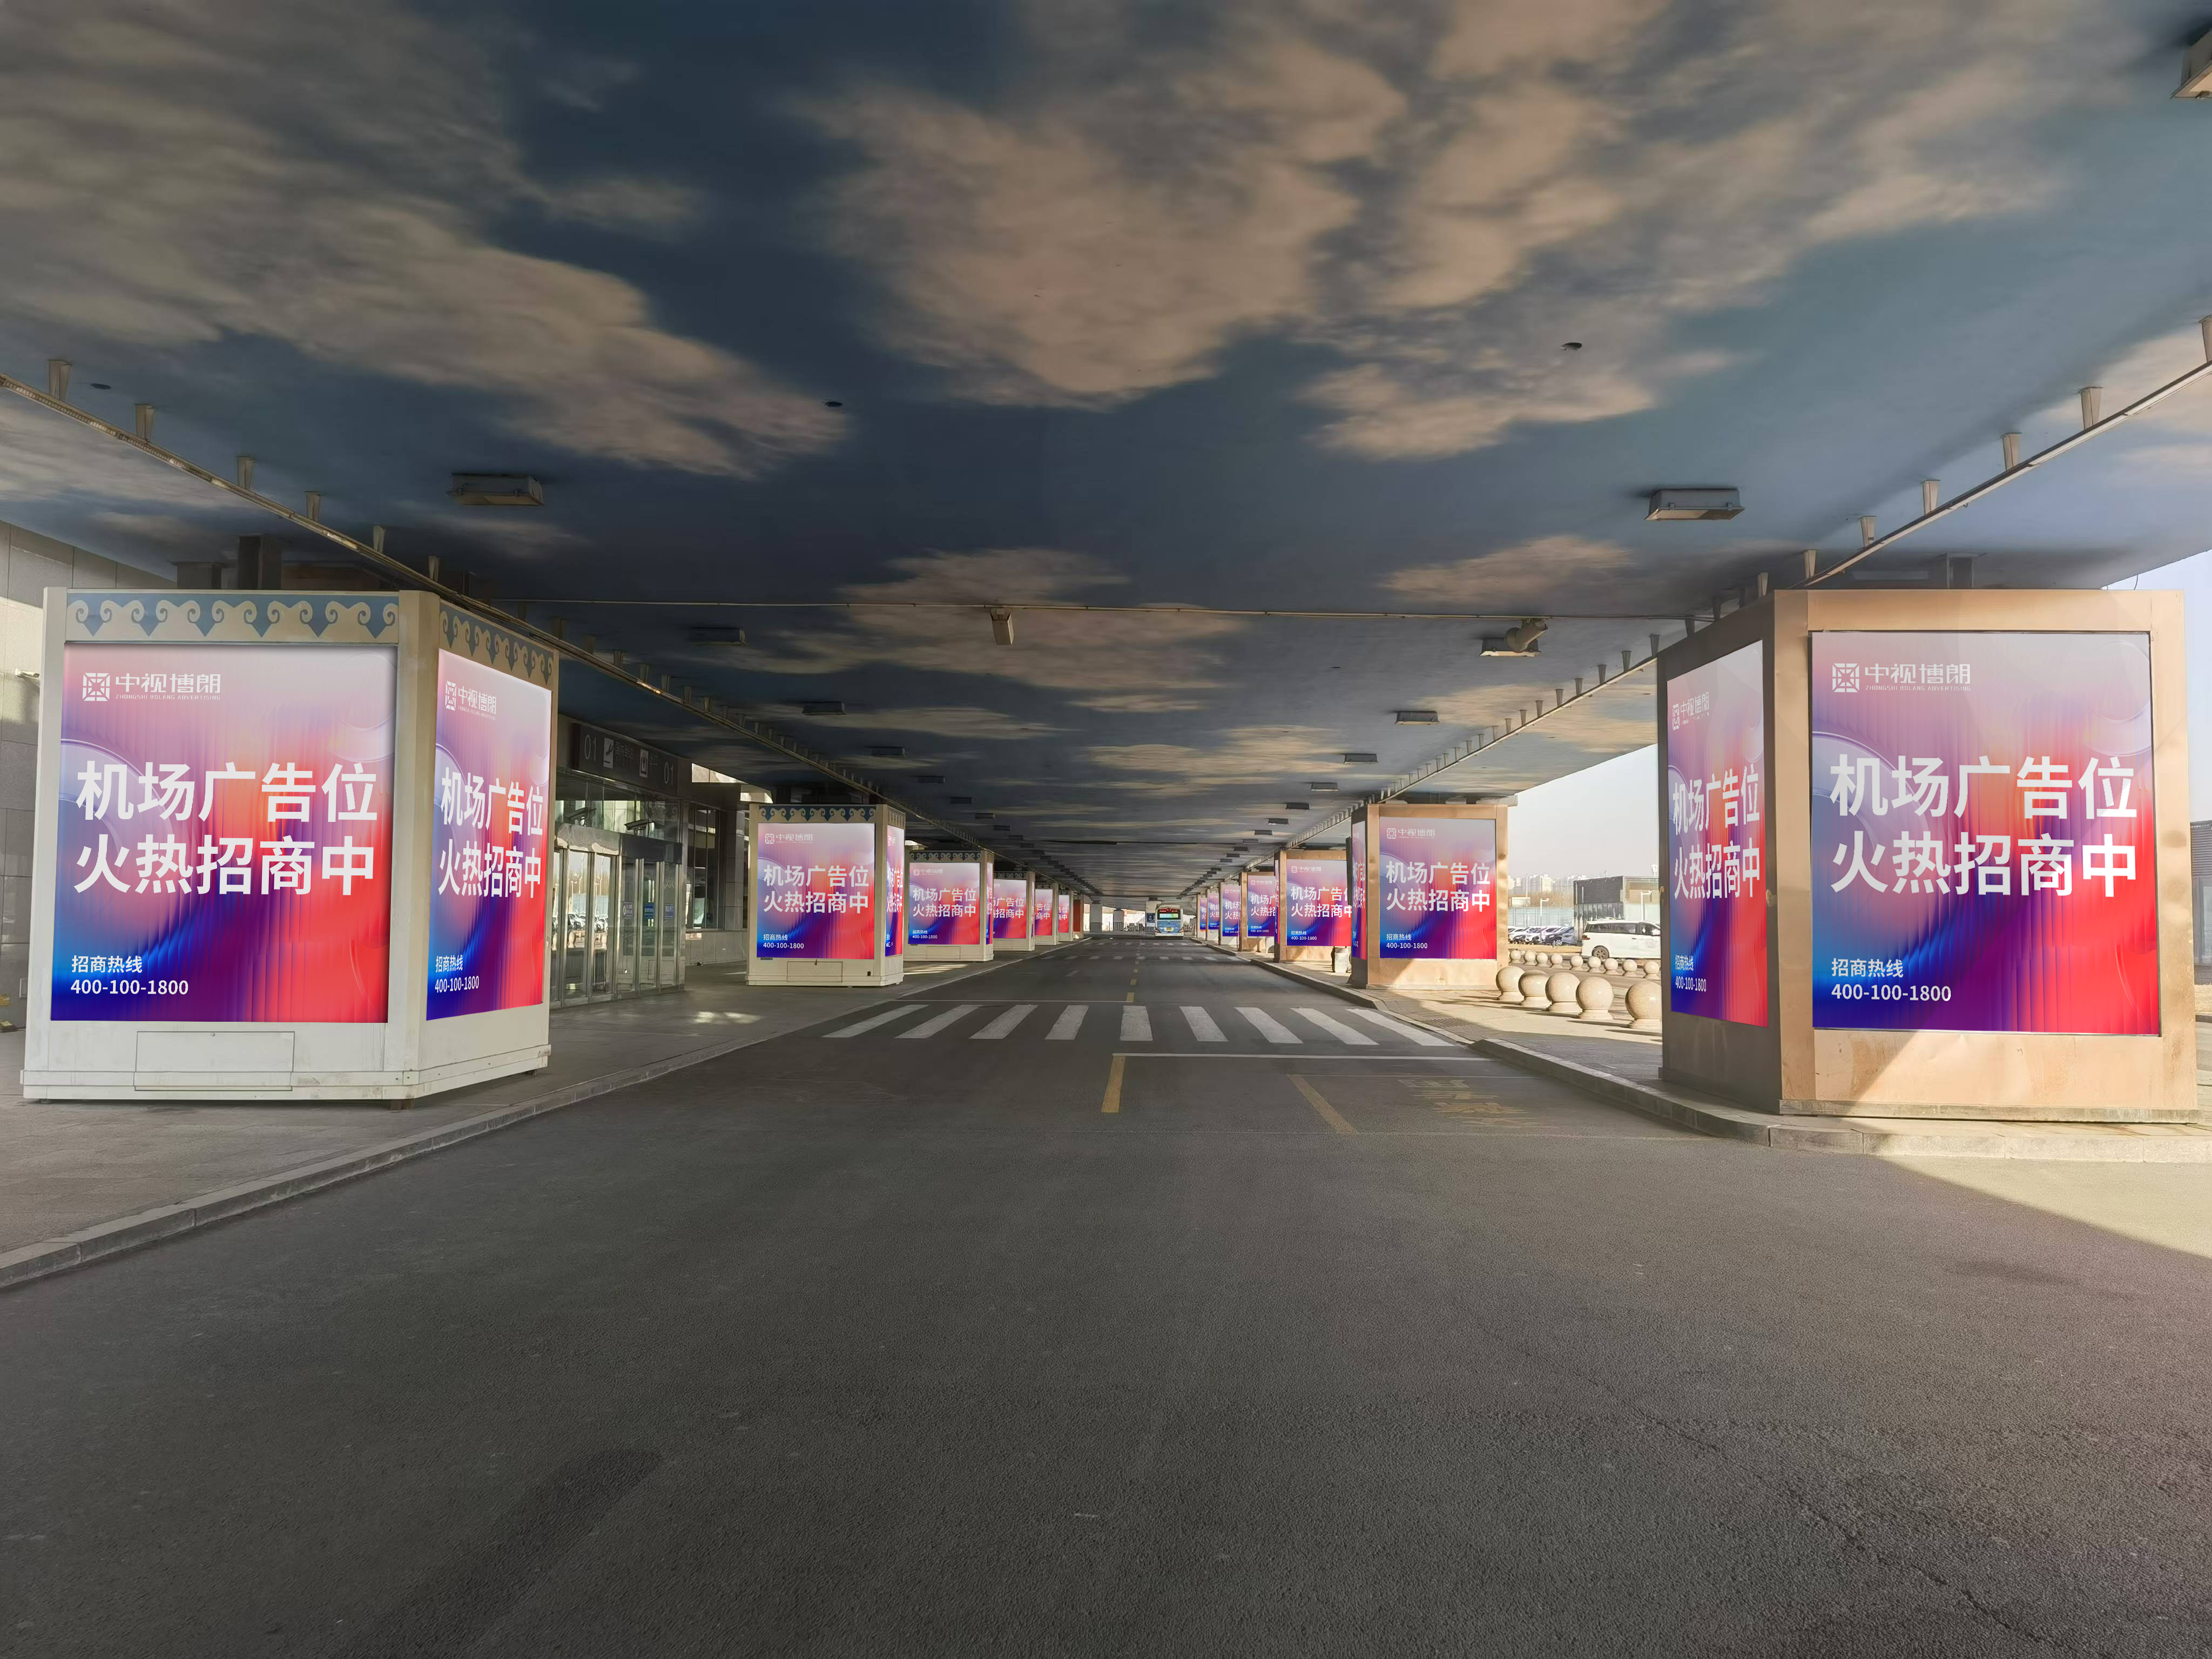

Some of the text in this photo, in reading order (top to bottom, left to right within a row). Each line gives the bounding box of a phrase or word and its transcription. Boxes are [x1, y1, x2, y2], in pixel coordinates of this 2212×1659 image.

[116, 673, 220, 693] 中视博朗
[1865, 664, 1970, 684] 中视博朗
[458, 686, 496, 714] 中视博朗
[1681, 691, 1709, 718] 中视博朗
[584, 734, 597, 760] 01
[76, 760, 378, 822] 机场广告位
[1830, 754, 2137, 820] 机场广告位
[441, 767, 543, 836] 机场广告位
[1673, 763, 1759, 835] 机场广告位
[73, 834, 375, 896] 火热招商中
[439, 839, 541, 898] 火热招商中
[764, 865, 869, 887] 机场广告位
[1386, 861, 1491, 885] 机场广告位
[1674, 837, 1760, 900] 火热招商中
[1831, 832, 2136, 898] 火热招商中
[764, 891, 868, 914] 火热招商中
[913, 888, 976, 902] 机场广告位
[1386, 888, 1489, 912] 火热招商中
[913, 904, 975, 917] 火热招商中
[993, 908, 1024, 918] 招商中
[1291, 903, 1352, 918] 火热招商中
[71, 955, 143, 973] 招商热线
[436, 954, 463, 973] 招商热线
[1675, 954, 1694, 971] 招商热线
[1831, 957, 1904, 979] 招商热线
[71, 979, 189, 995] 400-100-1800
[435, 975, 480, 993] 400-100-1800
[1675, 975, 1707, 992] 400-100-1800
[1831, 983, 1952, 1002] 400-100-1800
